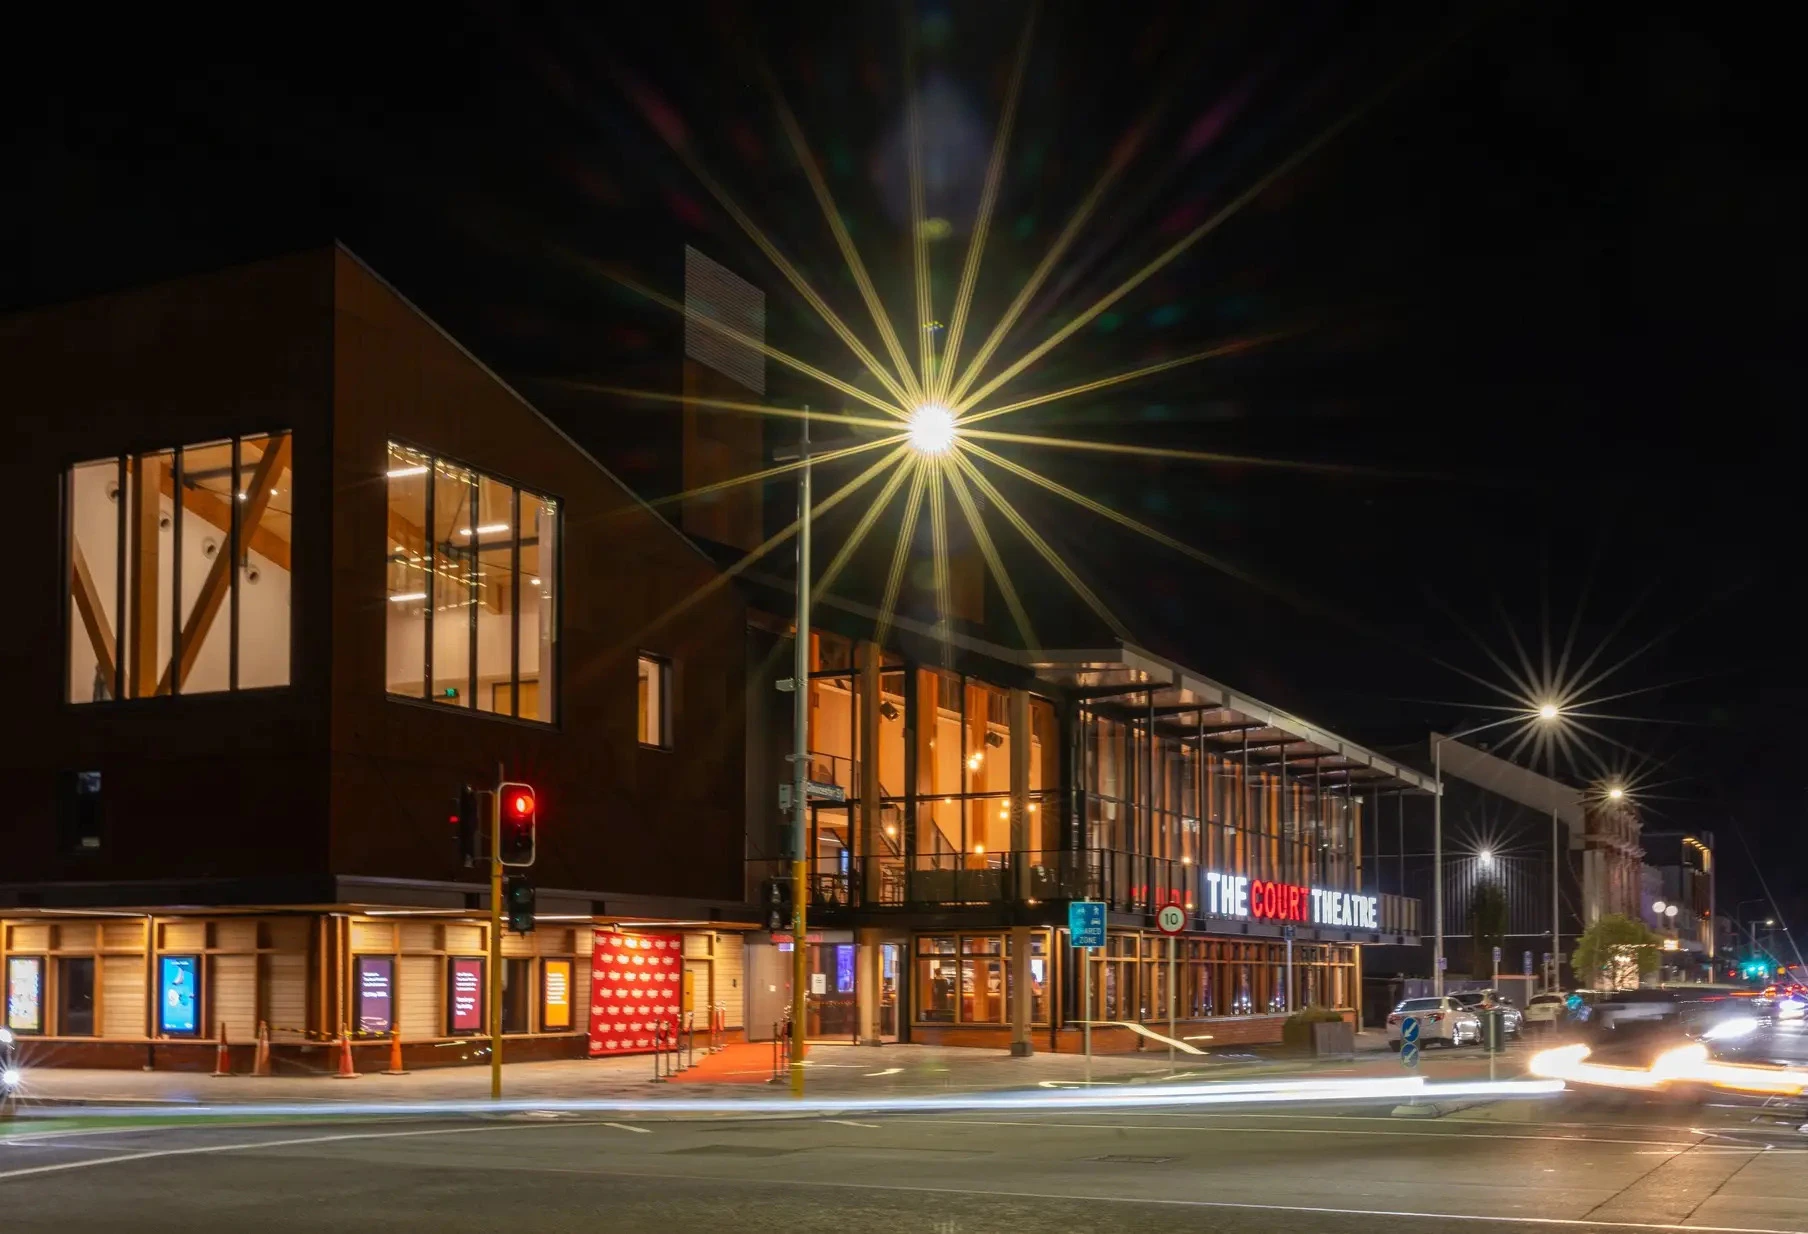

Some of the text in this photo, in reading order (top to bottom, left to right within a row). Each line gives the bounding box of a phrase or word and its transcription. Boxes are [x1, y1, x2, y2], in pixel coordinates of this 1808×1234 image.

[1207, 872, 1248, 916] THE
[1251, 879, 1310, 922] COURT
[1311, 888, 1377, 928] THEATRE
[1164, 913, 1178, 925] 10
[1079, 936, 1097, 944] ZONE
